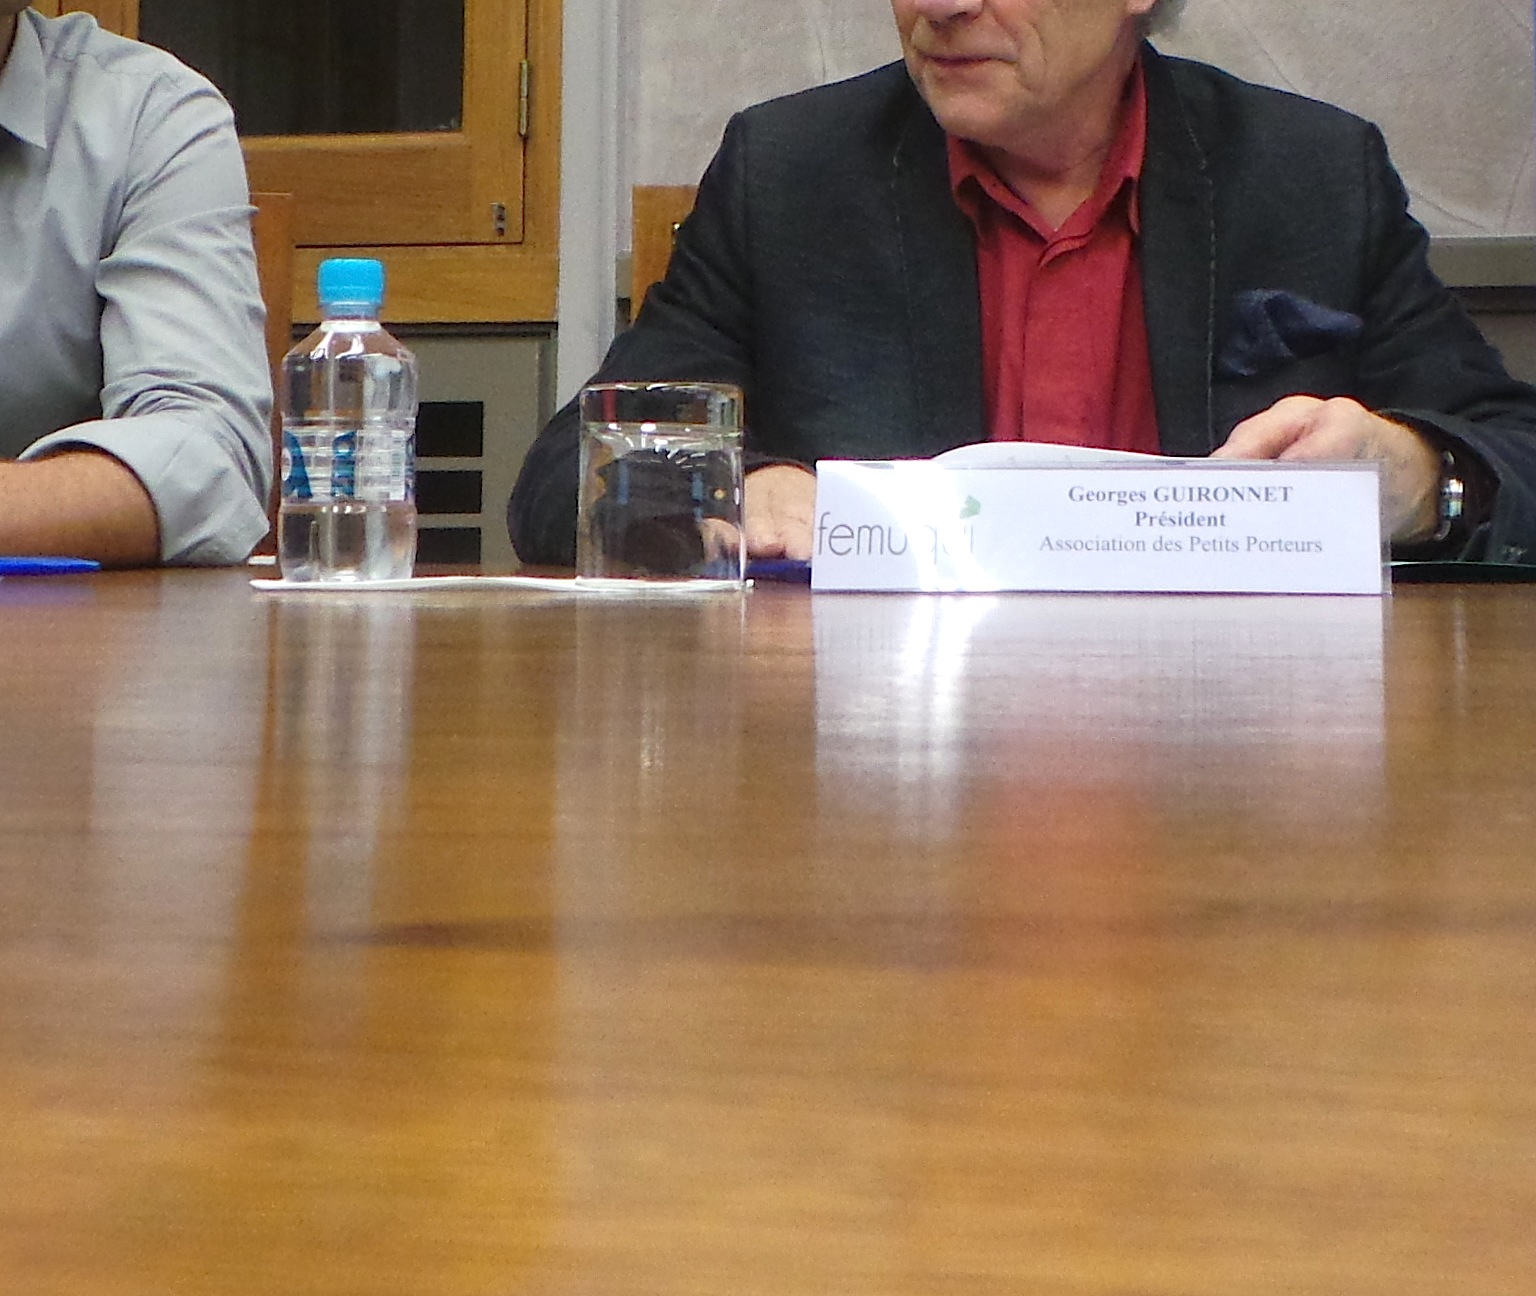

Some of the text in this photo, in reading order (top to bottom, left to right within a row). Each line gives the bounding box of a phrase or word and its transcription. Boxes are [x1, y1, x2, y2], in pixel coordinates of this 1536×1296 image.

[1068, 485, 1293, 506] Georges GUIRONNET
[1134, 510, 1227, 528] Président
[1039, 535, 1323, 553] Association des Petits Porteurs
